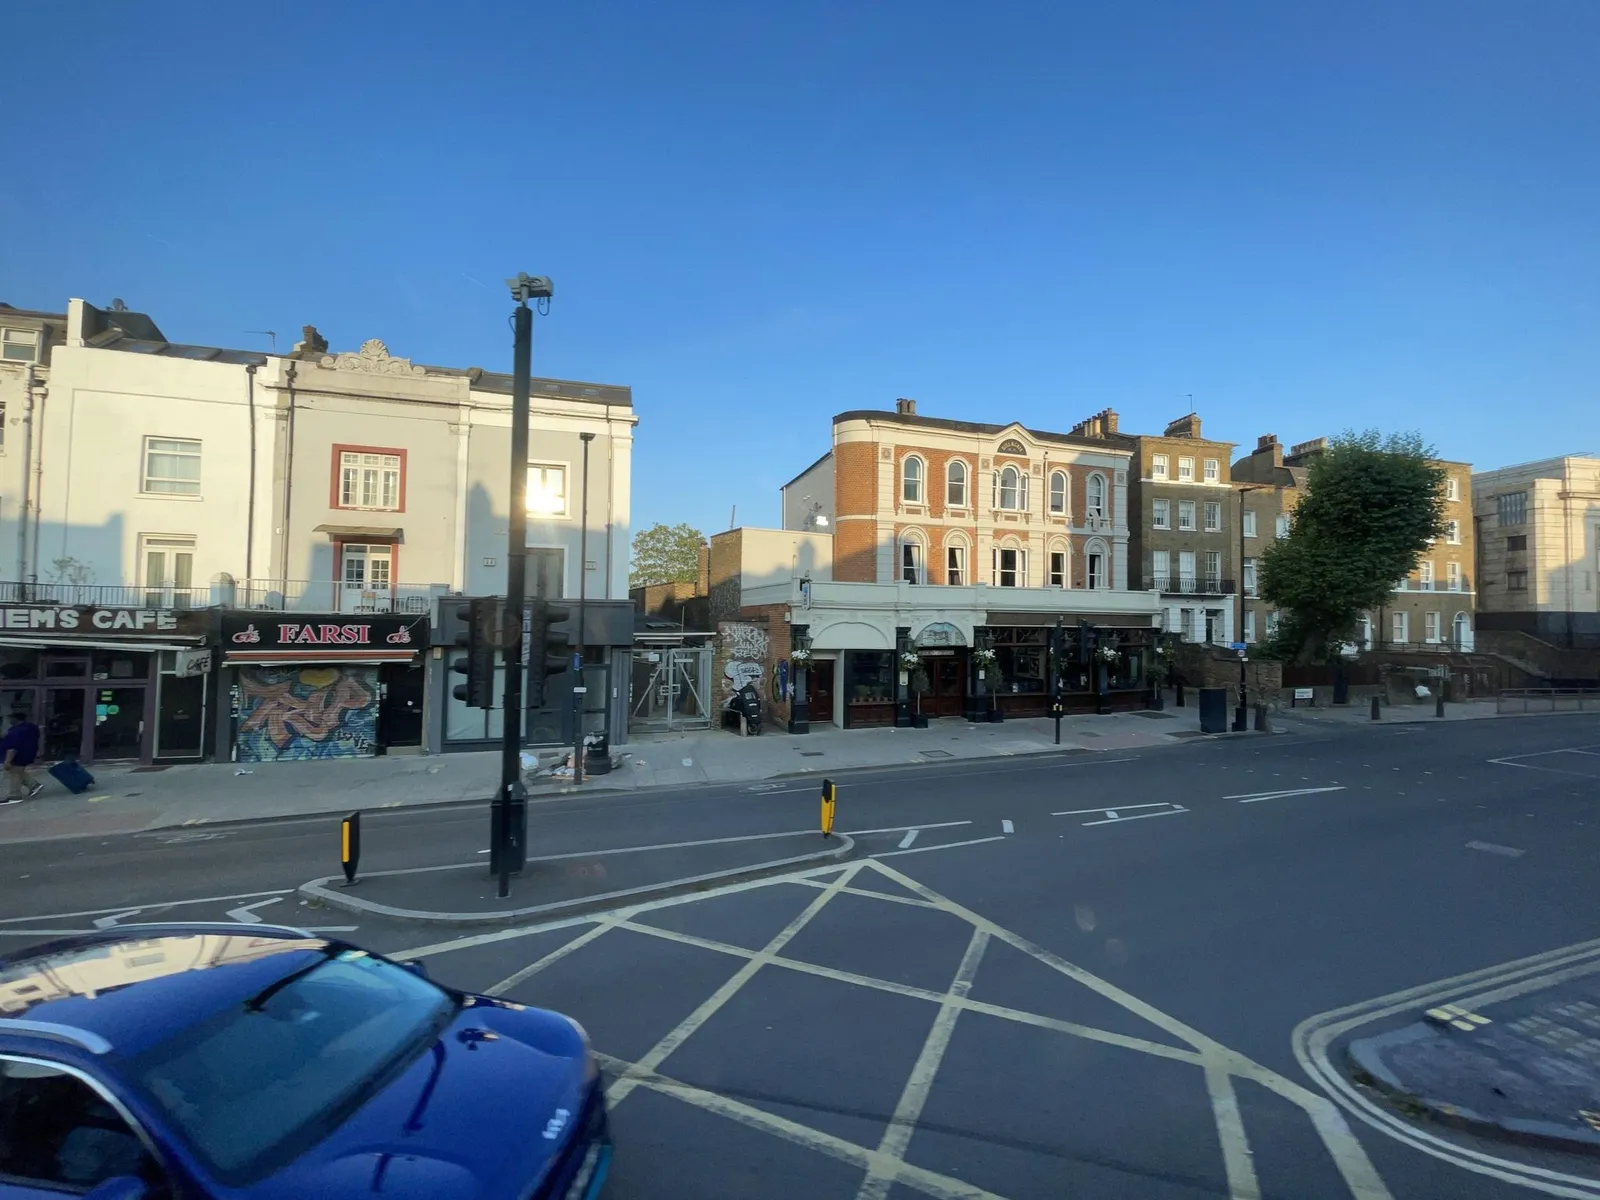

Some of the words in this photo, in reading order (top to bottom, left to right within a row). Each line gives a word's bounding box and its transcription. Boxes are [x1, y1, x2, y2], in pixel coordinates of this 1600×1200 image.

[0, 607, 79, 629] EM'S
[92, 610, 177, 630] CAFE
[277, 624, 371, 644] FARSI
[187, 656, 210, 670] CAFE
